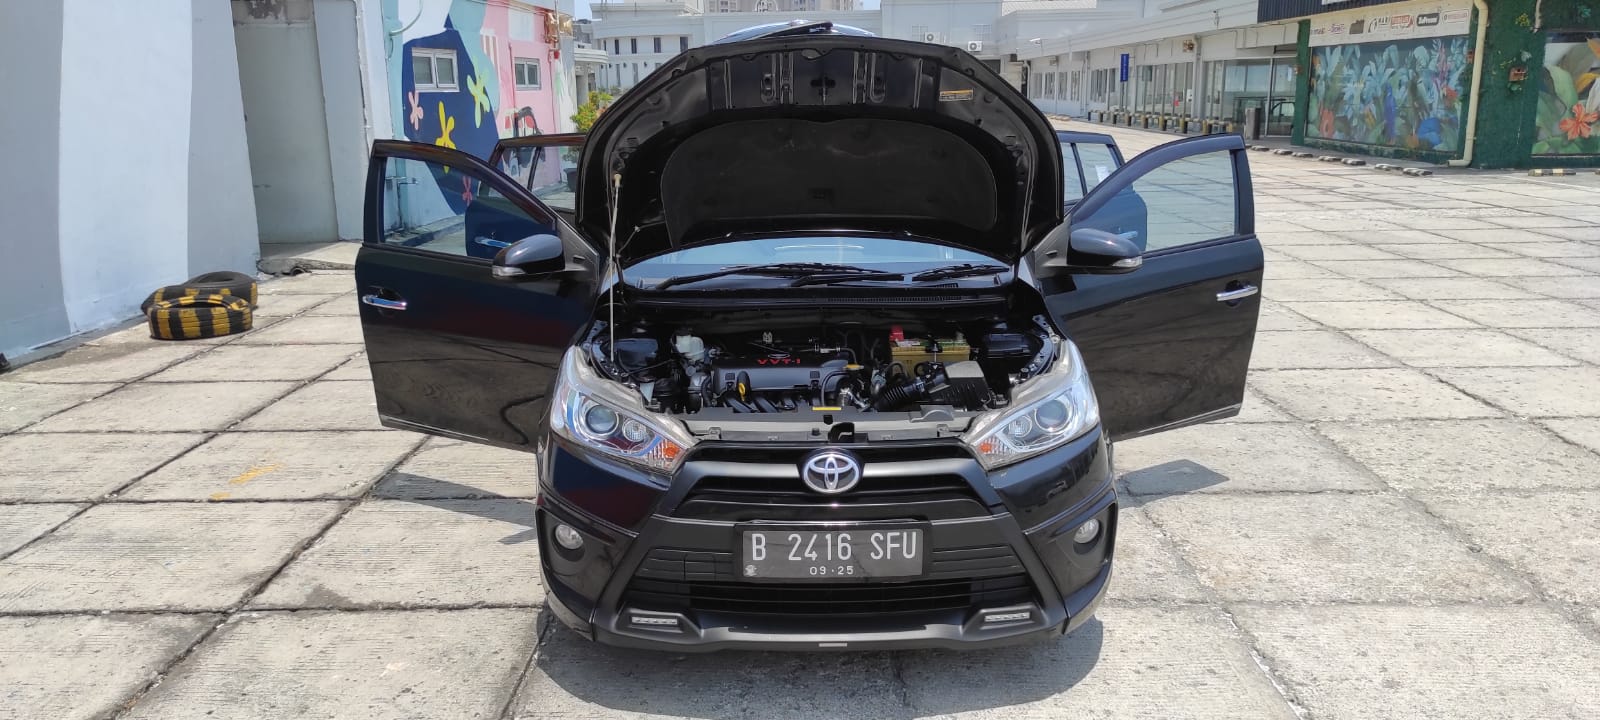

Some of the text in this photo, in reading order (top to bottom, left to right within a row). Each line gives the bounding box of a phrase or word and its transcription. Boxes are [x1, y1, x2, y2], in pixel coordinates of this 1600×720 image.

[751, 531, 917, 561] B 2416 SFU
